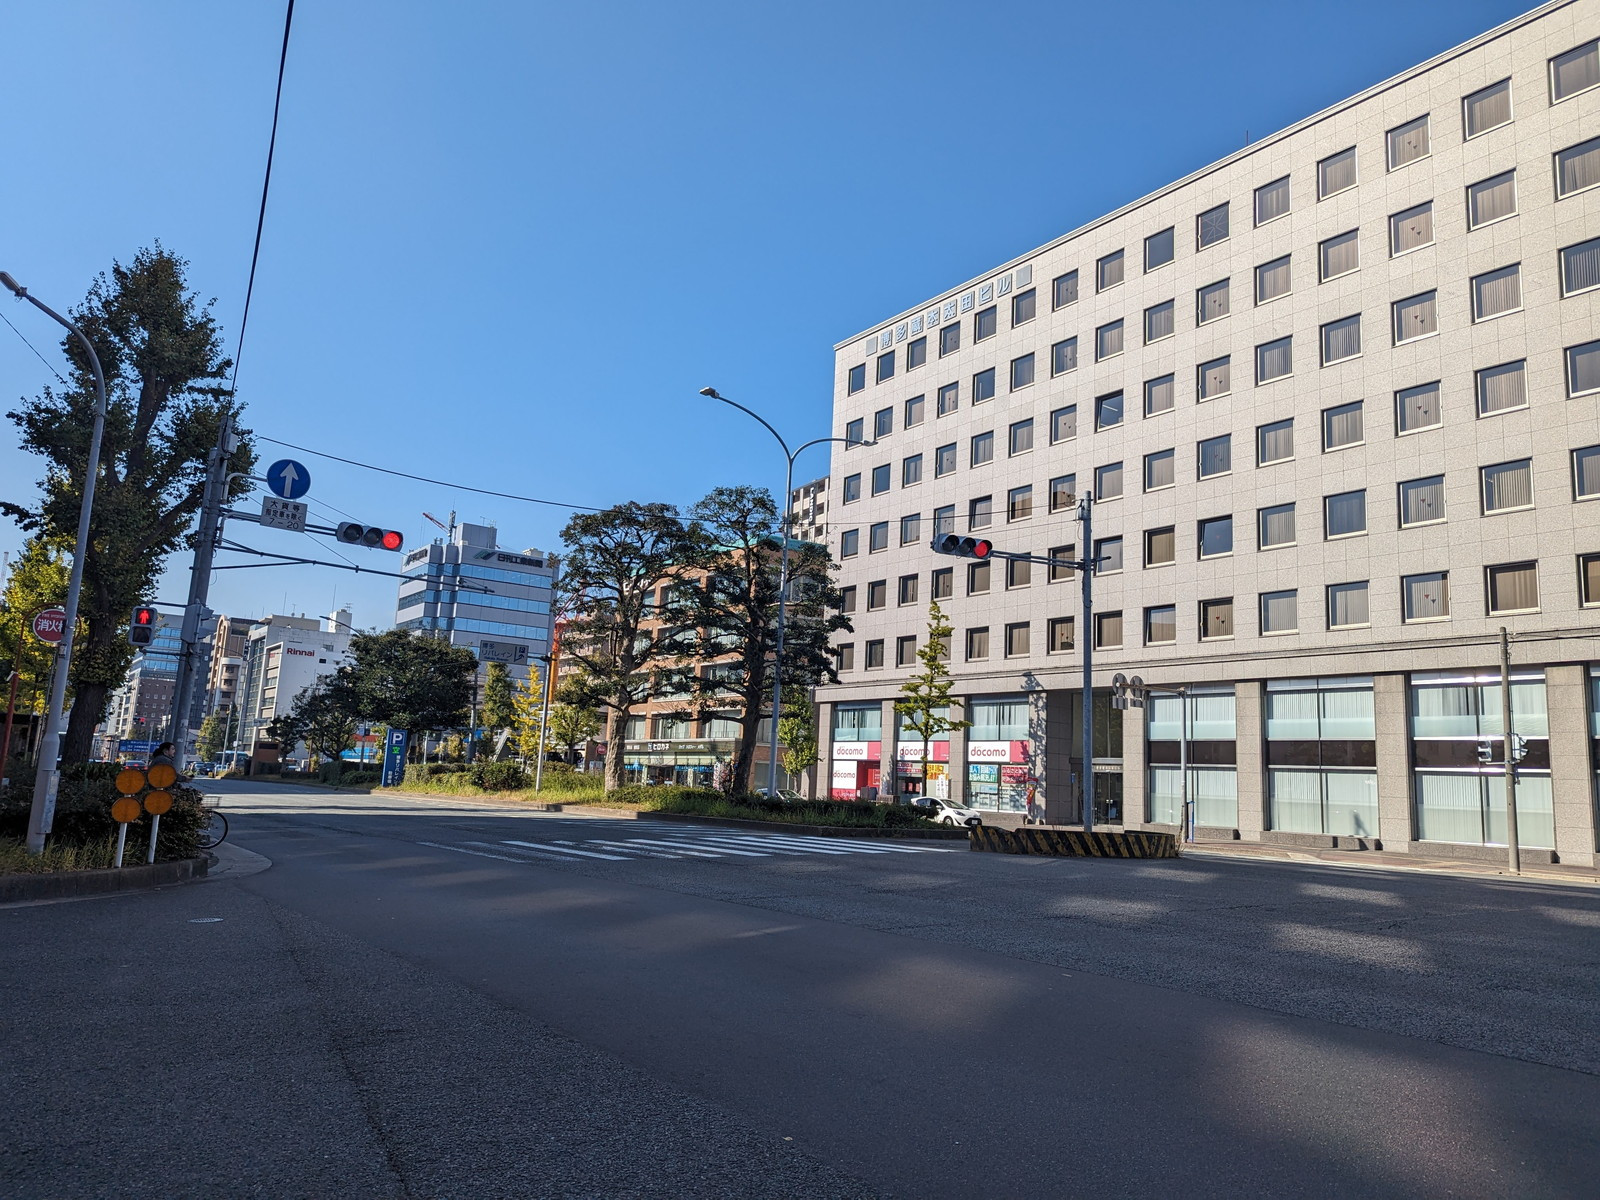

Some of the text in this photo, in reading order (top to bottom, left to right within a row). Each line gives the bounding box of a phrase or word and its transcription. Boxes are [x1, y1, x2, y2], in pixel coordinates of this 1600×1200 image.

[286, 647, 315, 657] Rinnai
[392, 733, 403, 745] P
[836, 746, 864, 756] docomo
[970, 746, 1007, 757] docomo
[833, 770, 856, 779] docomo
